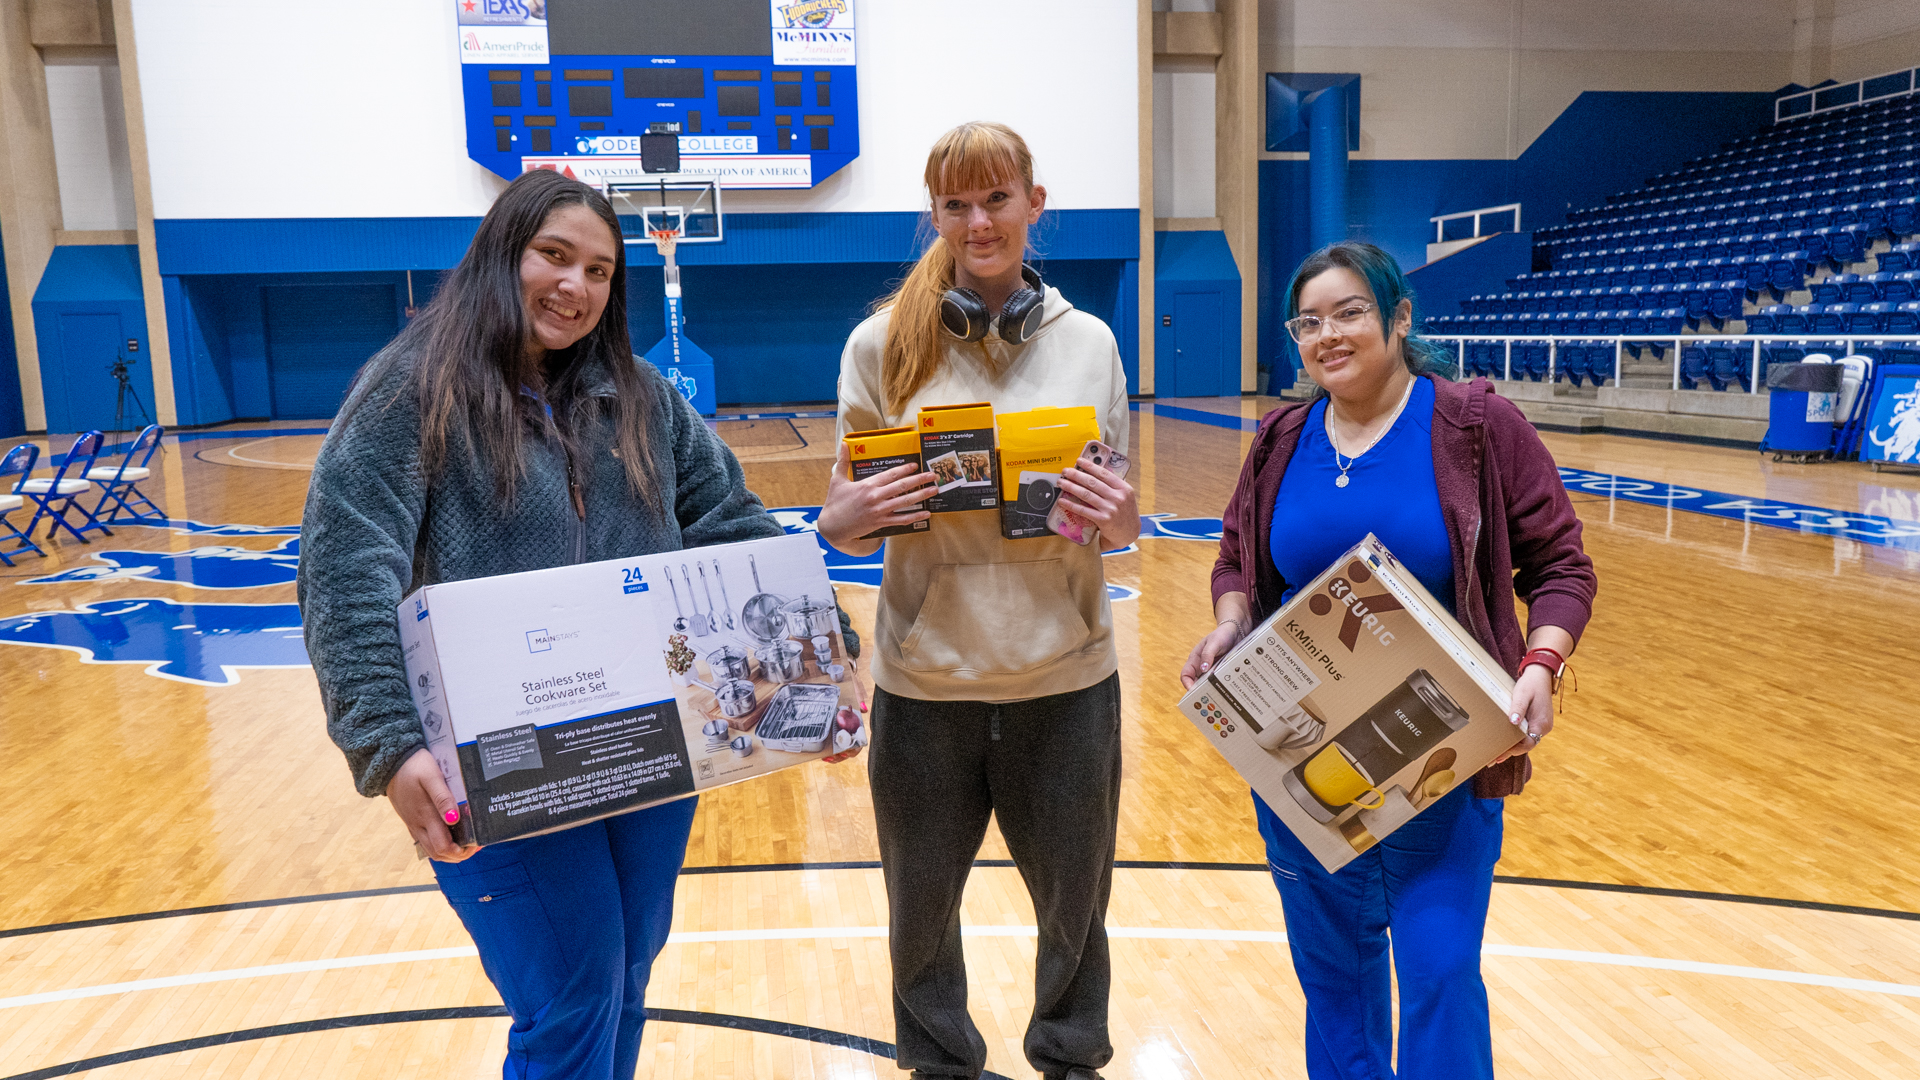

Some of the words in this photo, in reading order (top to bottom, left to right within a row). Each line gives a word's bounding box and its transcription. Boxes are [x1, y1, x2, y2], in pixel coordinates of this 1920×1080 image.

[483, 41, 544, 51] AmeriPride
[602, 139, 638, 151] ODE
[679, 138, 753, 151] COLLEGE
[584, 168, 640, 177] INVESTME
[741, 168, 754, 176] OF
[757, 167, 809, 176] AMERICA
[668, 299, 680, 363] WRANGLERS
[953, 431, 974, 439] Cartridge
[621, 567, 643, 583] 24
[627, 584, 644, 593] pieces
[1330, 580, 1395, 647] KEURIG
[535, 631, 579, 645] MAINSTAYS
[1264, 654, 1284, 675] STRONG
[1283, 674, 1299, 690] BREW
[1275, 644, 1287, 656] FITS
[1286, 656, 1314, 685] ANYWHERE
[1318, 654, 1342, 681] Plus
[521, 676, 573, 693] Stainless
[575, 667, 604, 682] Steel
[525, 686, 586, 705] Cookware
[588, 681, 607, 692] Set
[1243, 672, 1261, 692] REMOVABLE
[1251, 665, 1260, 674] YOUR
[1259, 674, 1273, 688] PERFECT
[1272, 689, 1286, 702] AMOUNT
[515, 707, 535, 717] Juego
[542, 701, 568, 710] cacerolas
[594, 691, 620, 699] inoxidable
[1232, 681, 1240, 689] FAST
[1241, 691, 1251, 702] FRESH
[1250, 701, 1263, 715] BREWED
[1253, 689, 1271, 708] RESERVOIR
[480, 730, 513, 744] Stainless
[514, 726, 533, 737] Steel
[554, 730, 575, 740] Tri-ply
[591, 721, 623, 732] distributes
[623, 717, 637, 725] heat
[637, 713, 656, 722] evenly
[1394, 708, 1422, 737] KEURIG
[488, 804, 498, 813] (4.7
[511, 800, 521, 808] pan
[521, 796, 532, 804] with
[550, 788, 563, 798] (25.4
[572, 782, 592, 792] casserole
[591, 779, 601, 787] with
[631, 769, 643, 777] 14.09
[664, 761, 673, 769] 35.8
[490, 793, 510, 803] Includes
[510, 791, 514, 799] 3
[514, 787, 538, 798] saucepans
[538, 783, 548, 792] with
[567, 777, 576, 785] (0.9
[591, 771, 600, 780] (1.9
[613, 767, 618, 775] qt
[618, 764, 627, 773] (2.8
[632, 760, 644, 769] Dutch
[511, 805, 530, 816] ramekin
[529, 802, 544, 811] bowls
[543, 799, 554, 807] with
[567, 793, 578, 802] solid
[596, 785, 612, 794] slotted
[628, 777, 644, 786] slotted
[557, 805, 568, 814] piece
[568, 799, 591, 809] measuring
[607, 791, 619, 800] Total
[624, 787, 638, 797] pieces
